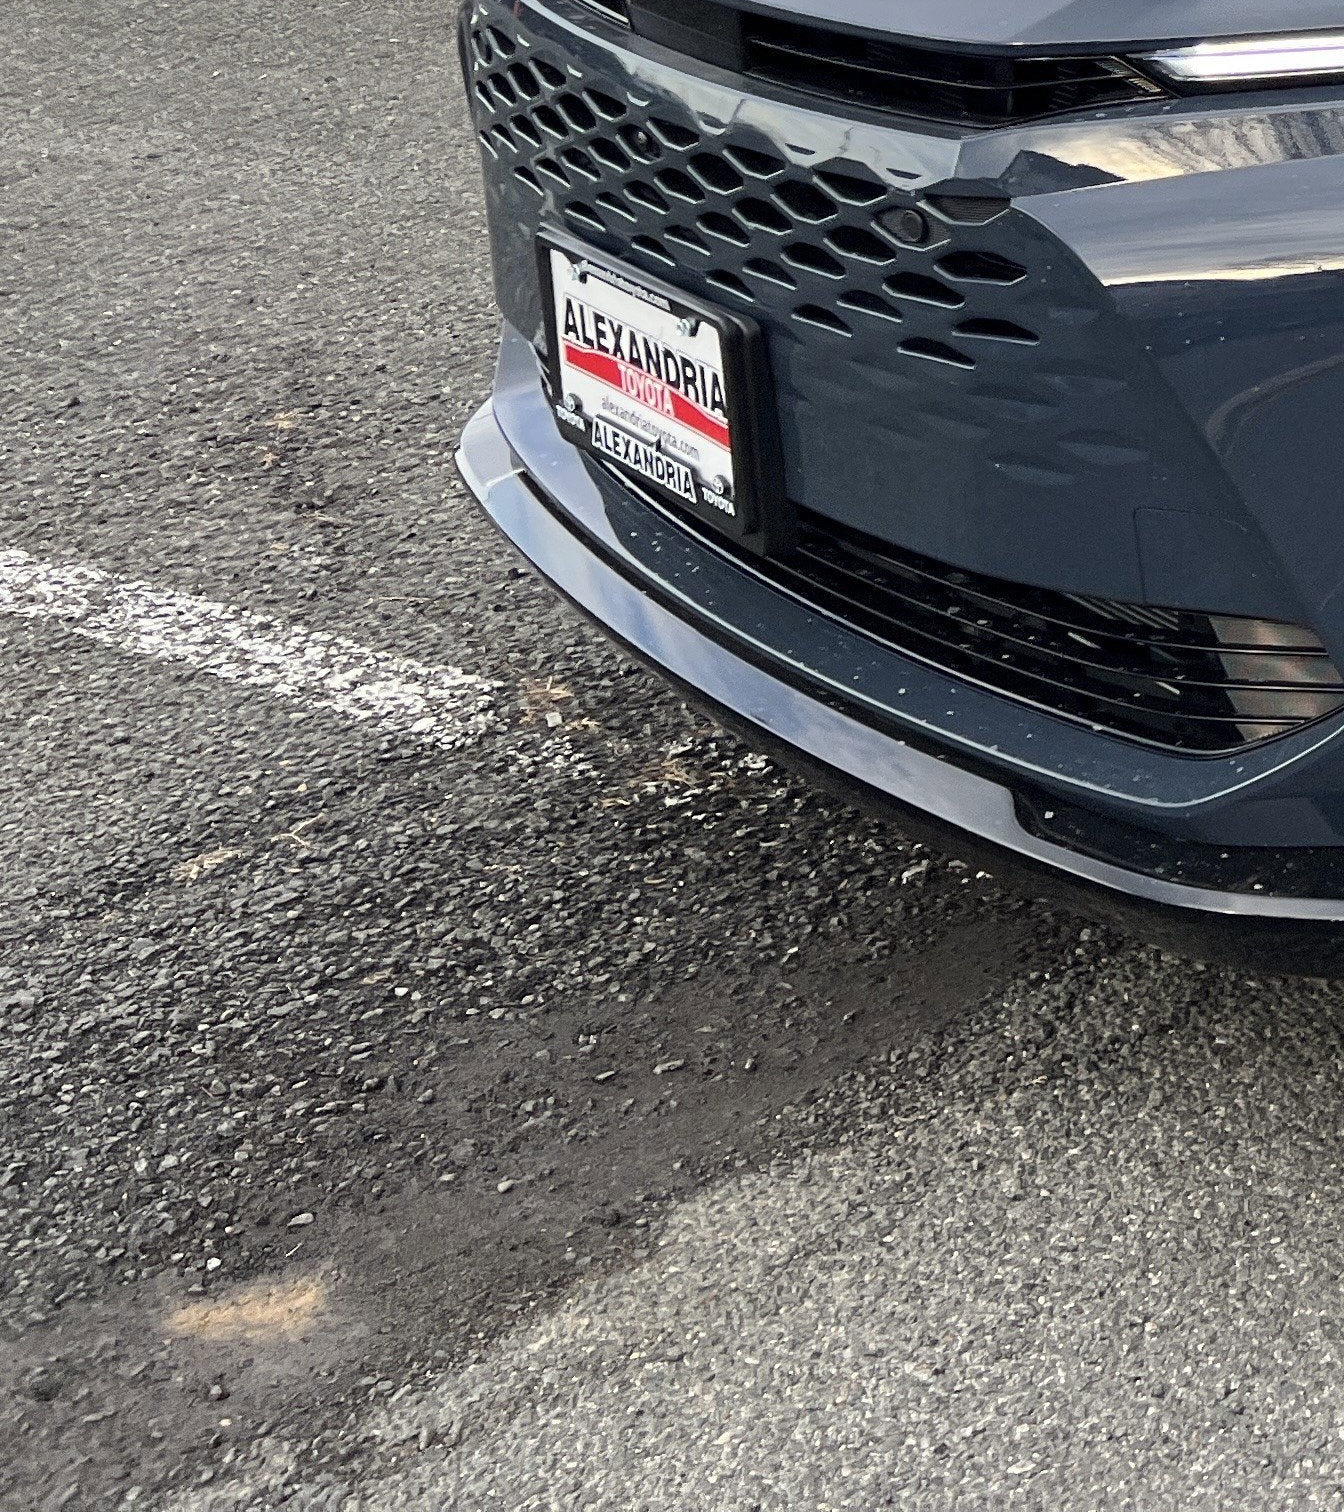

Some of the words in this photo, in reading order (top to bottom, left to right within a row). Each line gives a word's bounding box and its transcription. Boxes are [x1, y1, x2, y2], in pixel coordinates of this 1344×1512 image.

[563, 297, 728, 415] ALEXANDRIA
[618, 364, 676, 418] TOYOTA
[593, 421, 696, 501] ALEXANDRIA
[701, 486, 736, 517] TOYOTA
